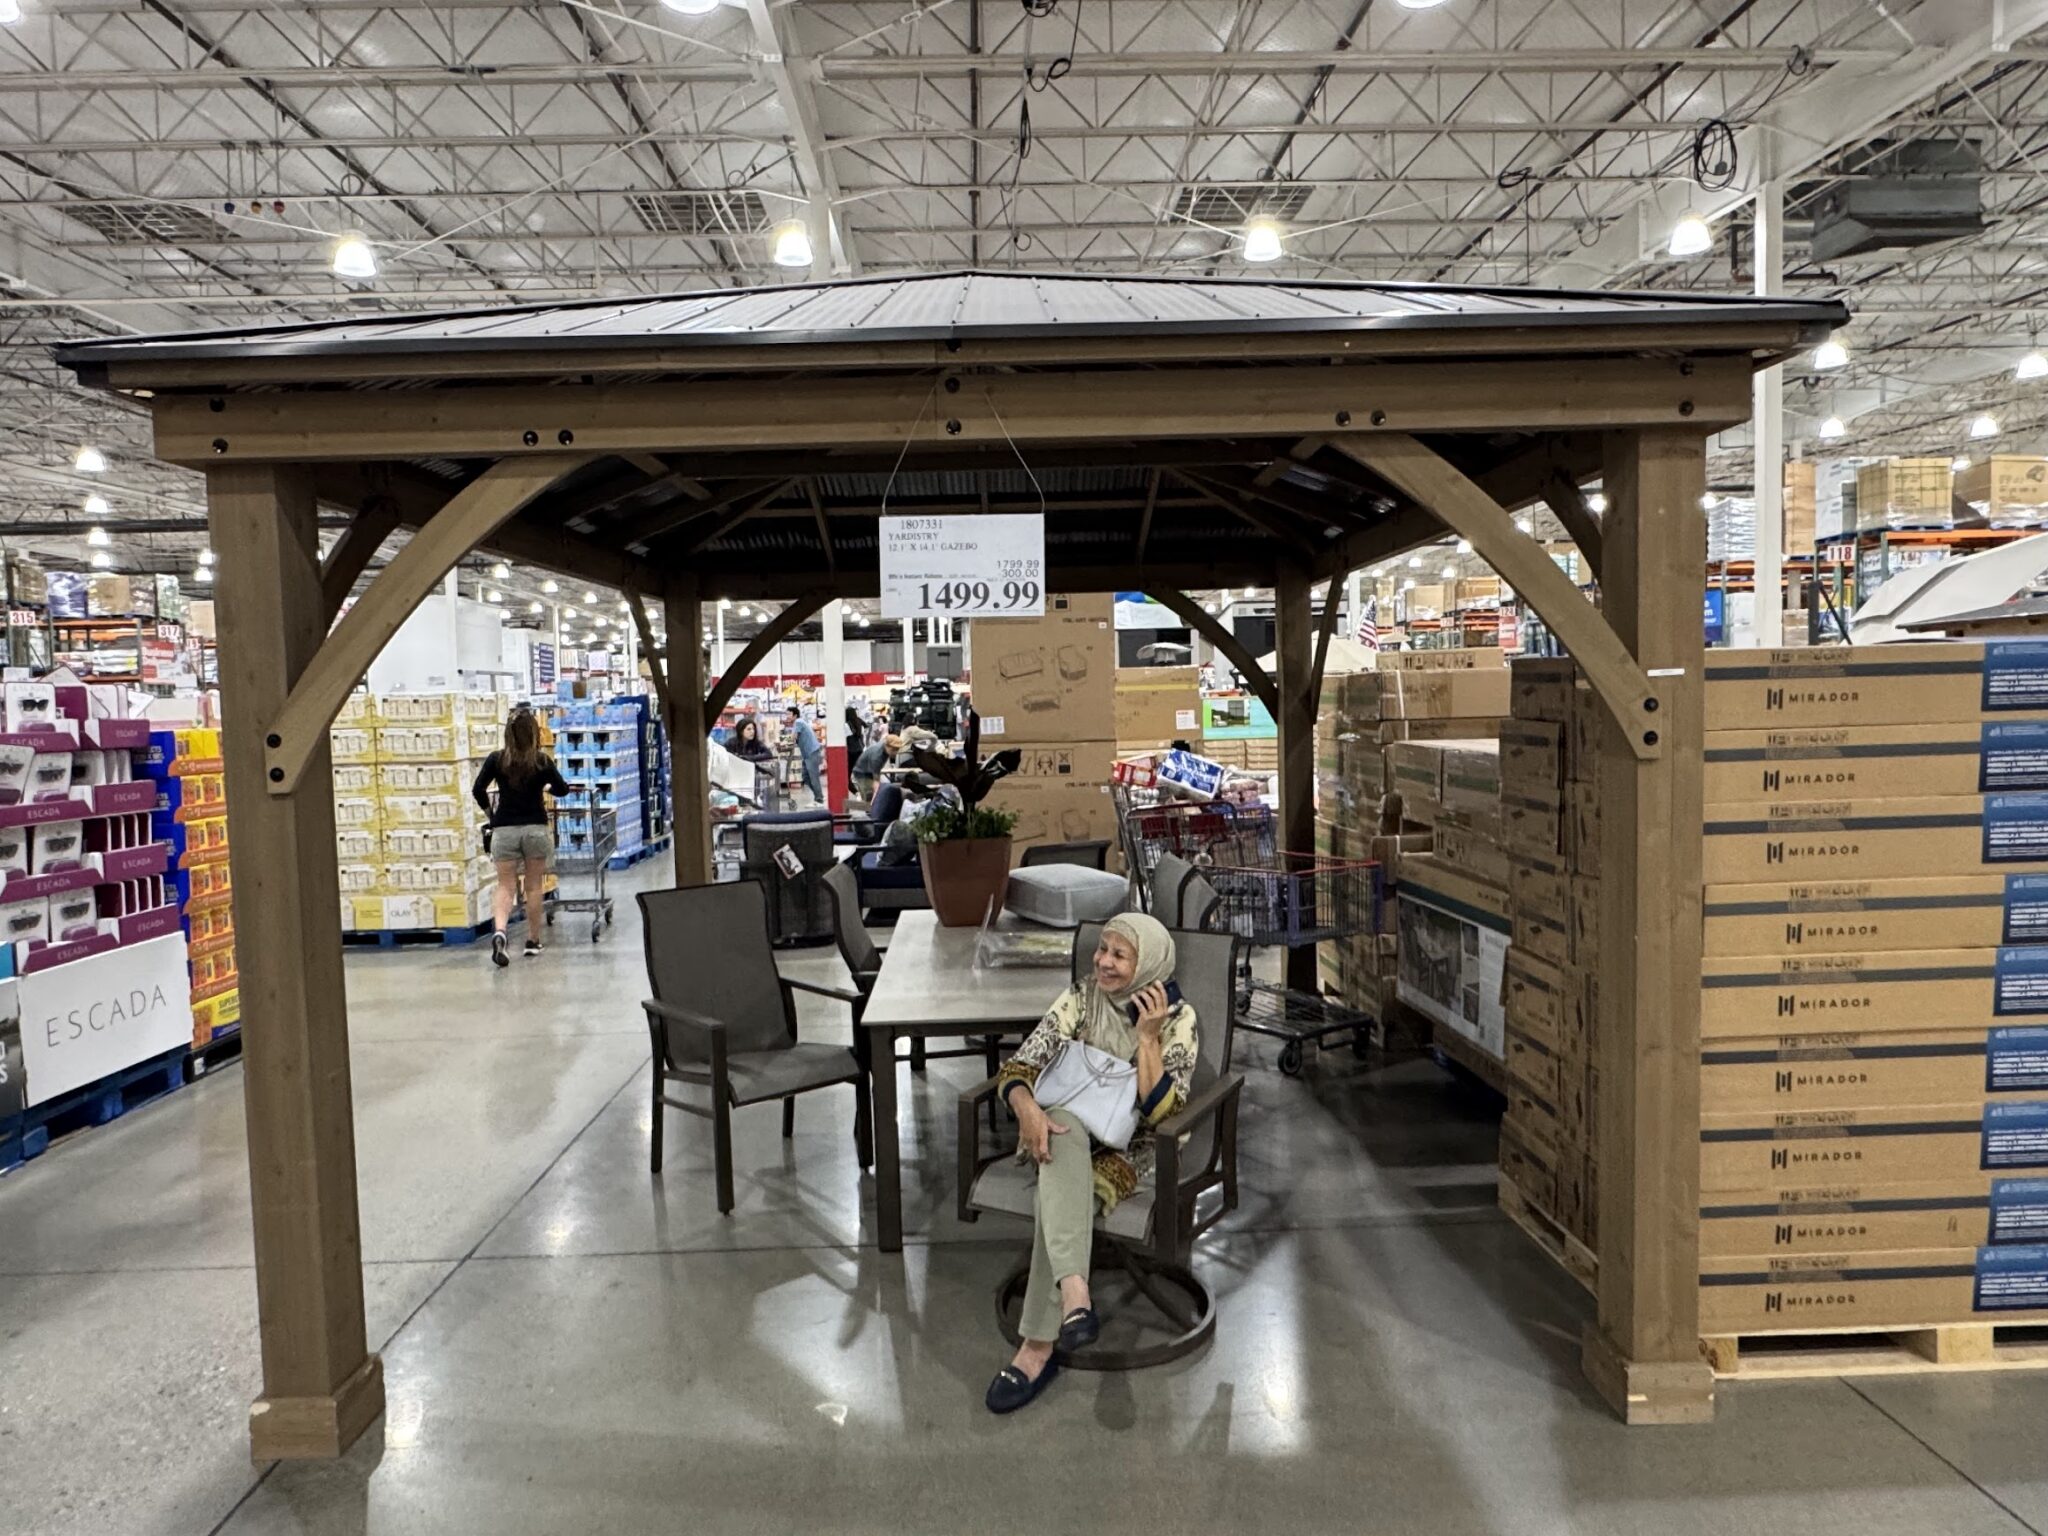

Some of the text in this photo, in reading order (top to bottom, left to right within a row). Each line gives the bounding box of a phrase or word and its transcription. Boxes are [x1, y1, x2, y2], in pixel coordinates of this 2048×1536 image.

[901, 519, 943, 530] 1807331
[888, 532, 939, 541] YARDISTRY
[910, 543, 917, 551] X
[940, 543, 978, 551] GAZEBO
[1830, 546, 1852, 560] 118
[918, 581, 1040, 610] 1499.99
[12, 612, 35, 625] 315
[160, 626, 178, 637] 317
[1788, 691, 1859, 704] MIRADOR
[1785, 773, 1856, 786] MIRADOR
[27, 807, 61, 820] ESCADA
[1788, 845, 1860, 857] MIRADOR
[122, 857, 151, 870] ESCADA
[36, 877, 71, 892] ESCADA
[137, 918, 165, 932] ESCADA
[1807, 925, 1878, 938] MIRADOR
[57, 944, 89, 960] ESCADA
[1800, 997, 1871, 1010] MIRADOR
[47, 984, 168, 1048] ESCADA
[1796, 1073, 1868, 1087] MIRADOR
[1792, 1151, 1863, 1164] MIRADOR
[1796, 1226, 1867, 1238] MIRADOR
[1786, 1294, 1857, 1307] MIRADOR
